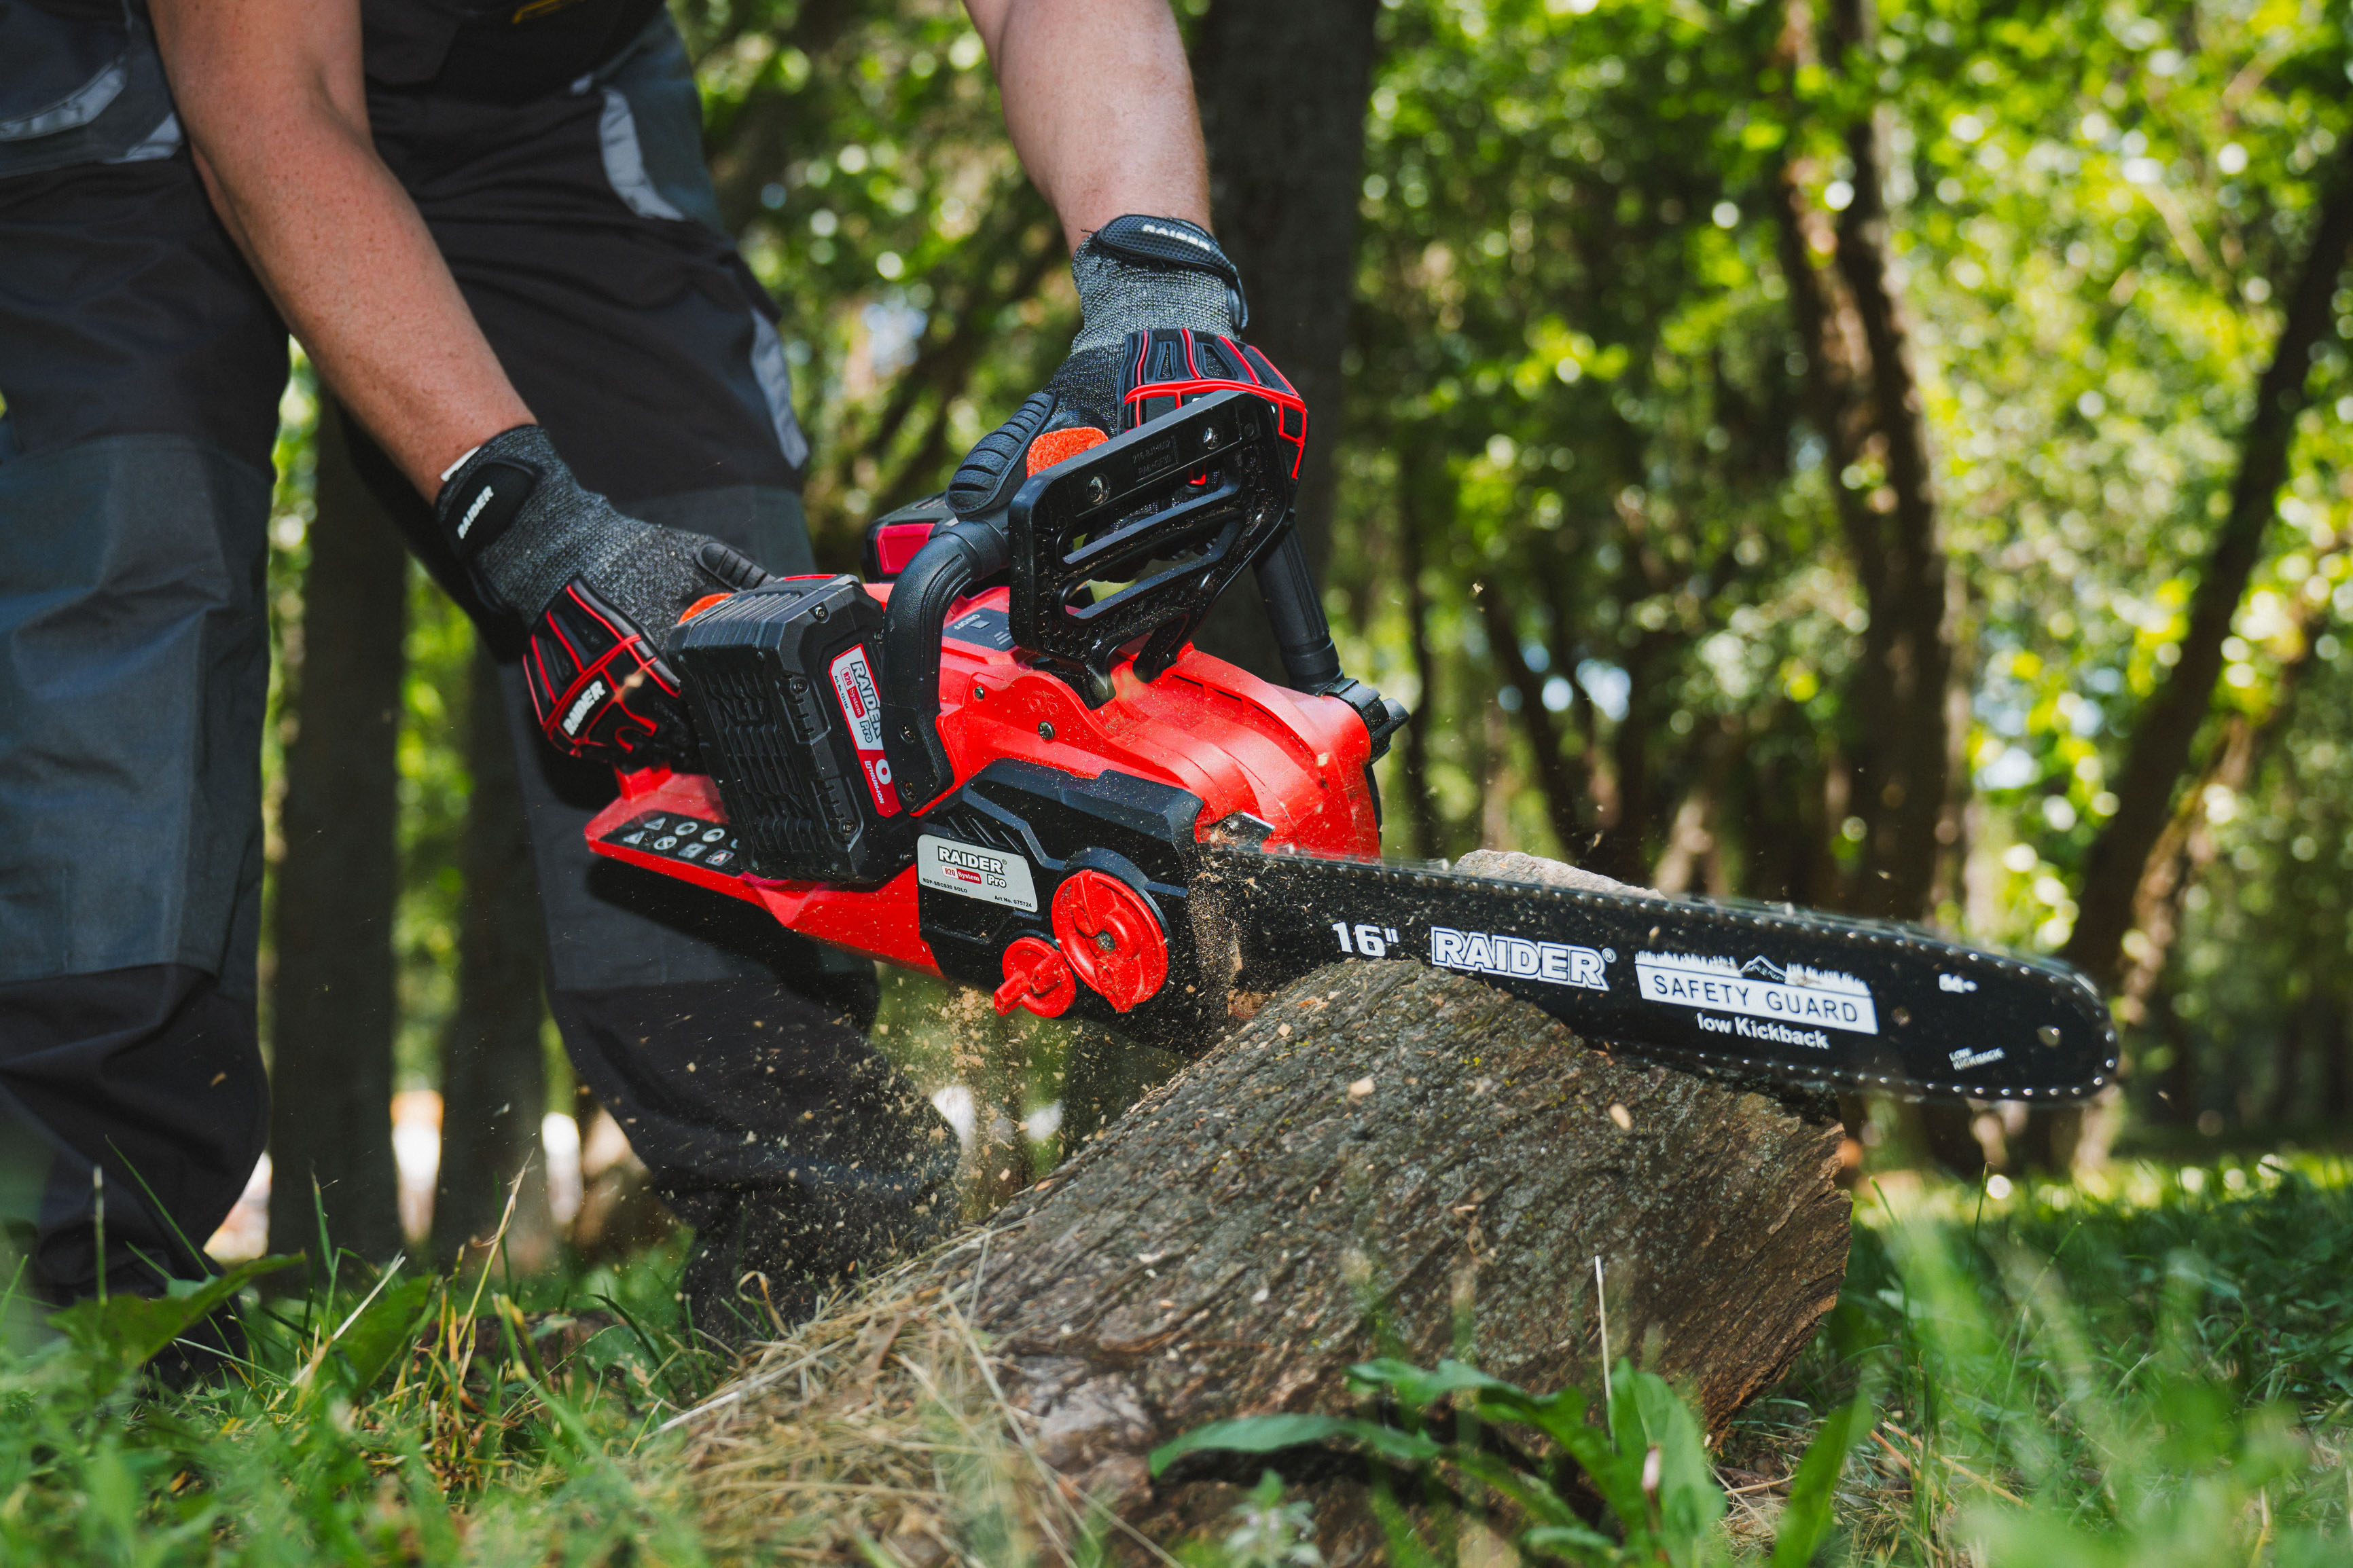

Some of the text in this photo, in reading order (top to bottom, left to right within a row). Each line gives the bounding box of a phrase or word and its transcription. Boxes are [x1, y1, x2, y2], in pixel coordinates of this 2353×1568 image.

[457, 486, 495, 539] RAIDER
[843, 672, 862, 716] R20 System
[859, 720, 873, 744] Pro
[864, 761, 885, 804] LITHIUM-ION
[945, 867, 980, 882] R20 System
[987, 873, 1007, 888] Pro
[1013, 898, 1032, 909] 075724
[1653, 974, 1859, 1024] SAFETY GUARD
[1697, 1013, 1829, 1051] low Kickback
